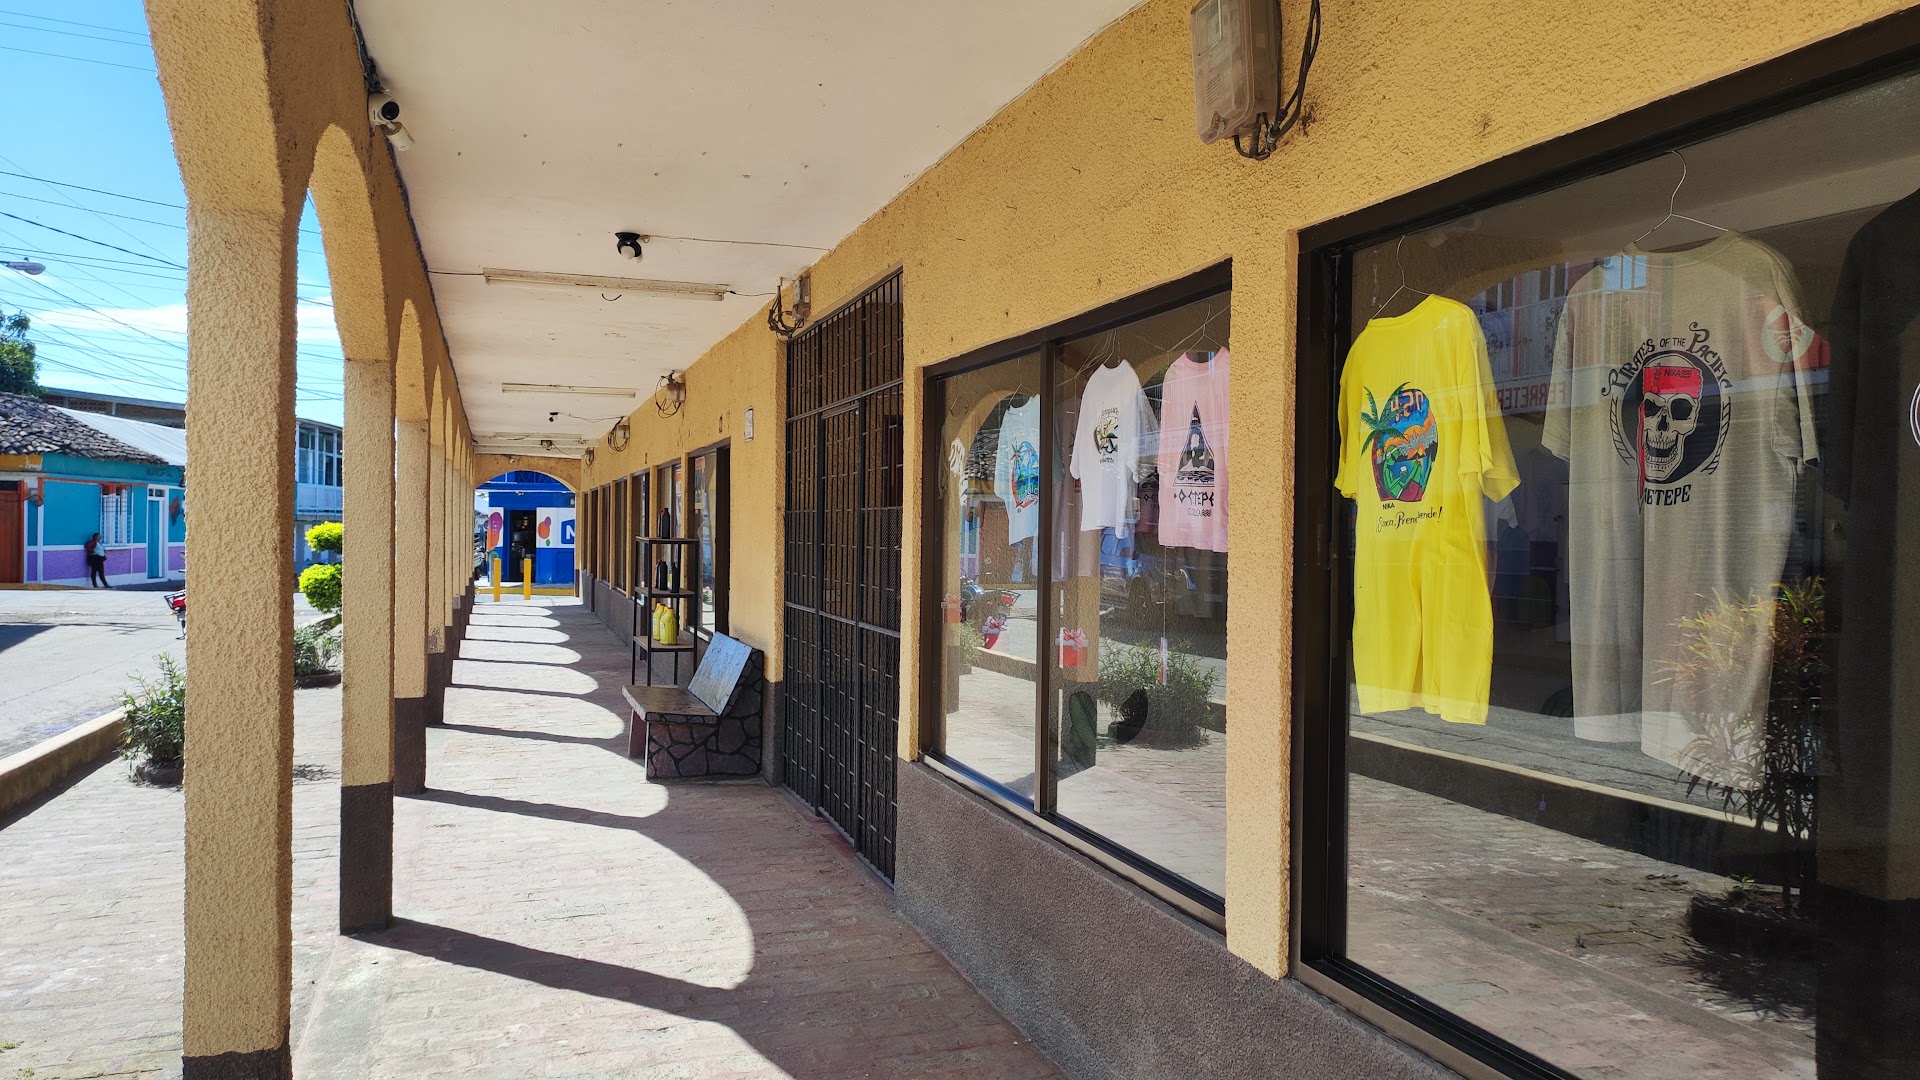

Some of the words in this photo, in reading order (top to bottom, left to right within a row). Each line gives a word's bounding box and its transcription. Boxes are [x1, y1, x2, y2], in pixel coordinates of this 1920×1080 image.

[1659, 338, 1671, 348] OF
[1673, 337, 1687, 347] THE
[1664, 368, 1680, 377] NIKA
[1644, 484, 1692, 506] ETEPE
[1382, 502, 1396, 510] NIKA
